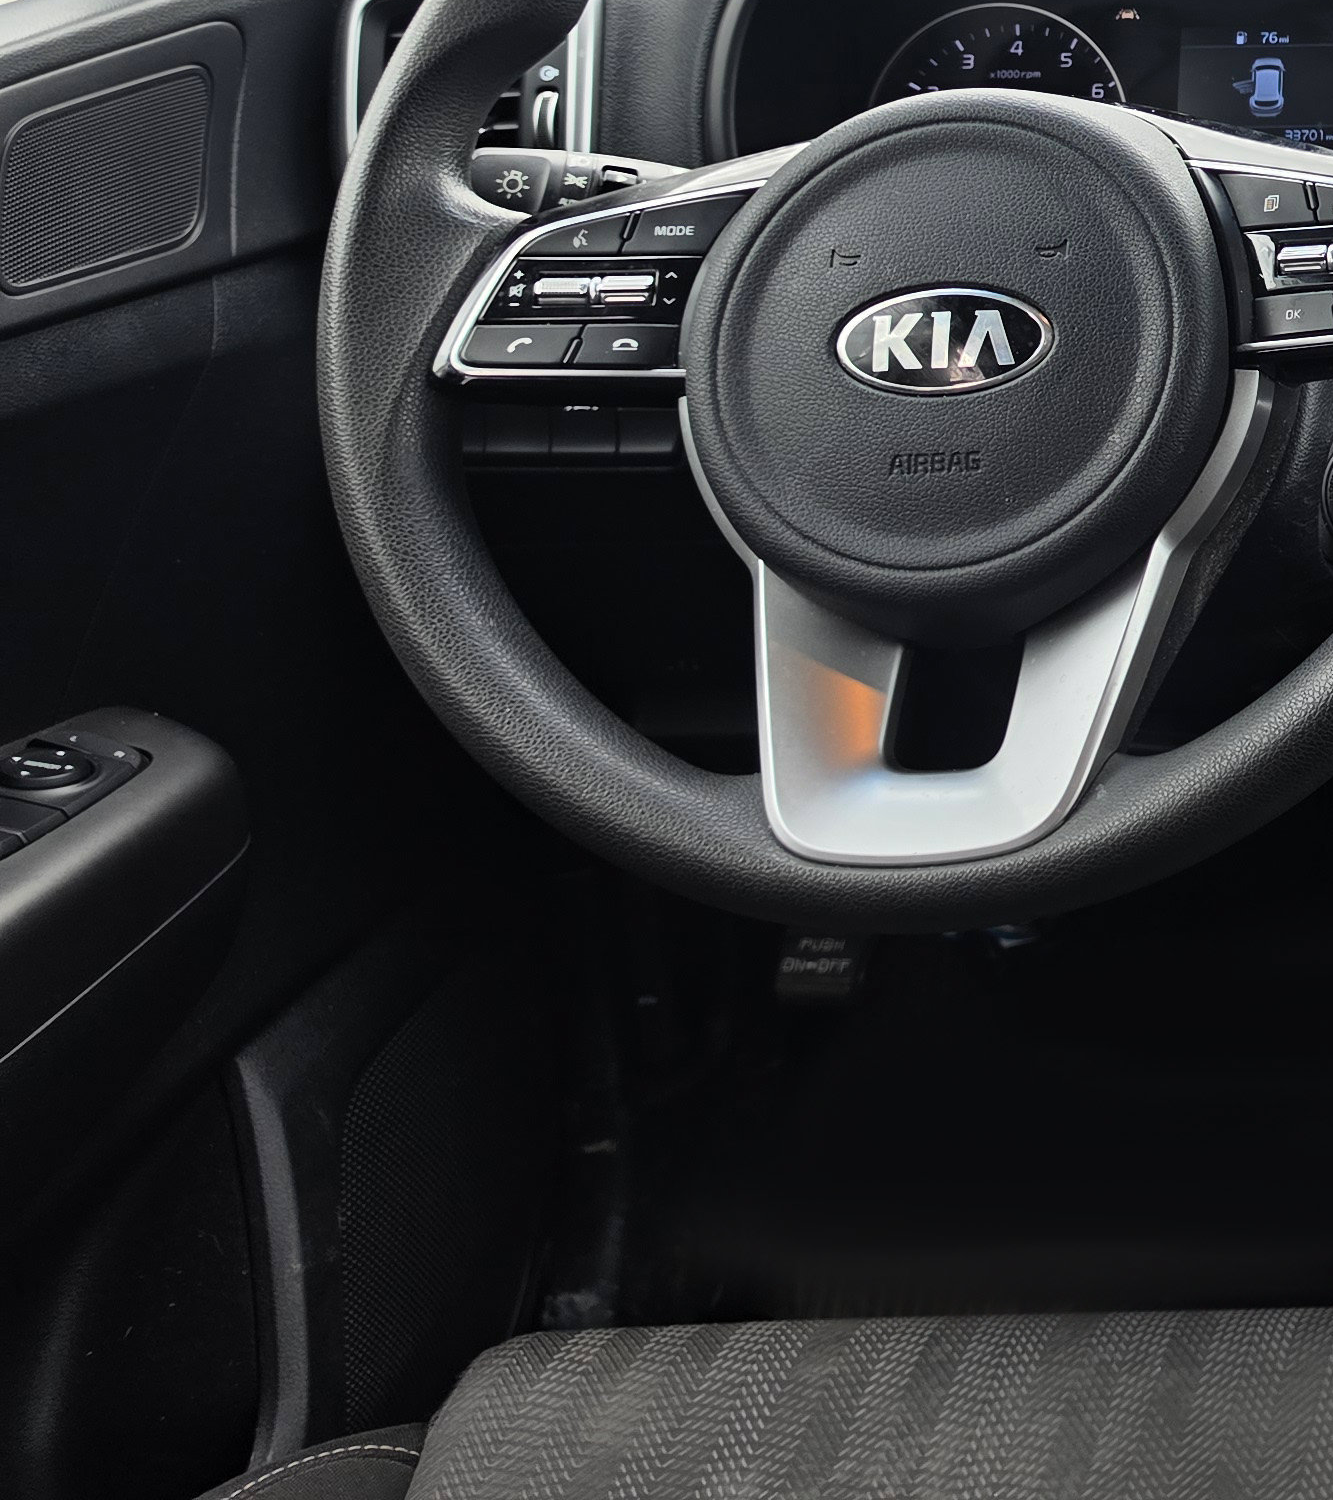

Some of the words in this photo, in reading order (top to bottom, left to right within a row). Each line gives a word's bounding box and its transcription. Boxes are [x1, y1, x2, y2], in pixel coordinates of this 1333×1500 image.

[1009, 40, 1024, 56] 4
[962, 53, 975, 70] 3
[1060, 52, 1073, 68] 5
[1091, 83, 1105, 99] 6
[654, 225, 695, 237] MODE
[1285, 309, 1302, 321] OK
[870, 308, 1016, 373] KIA
[888, 449, 983, 476] AIRBAG
